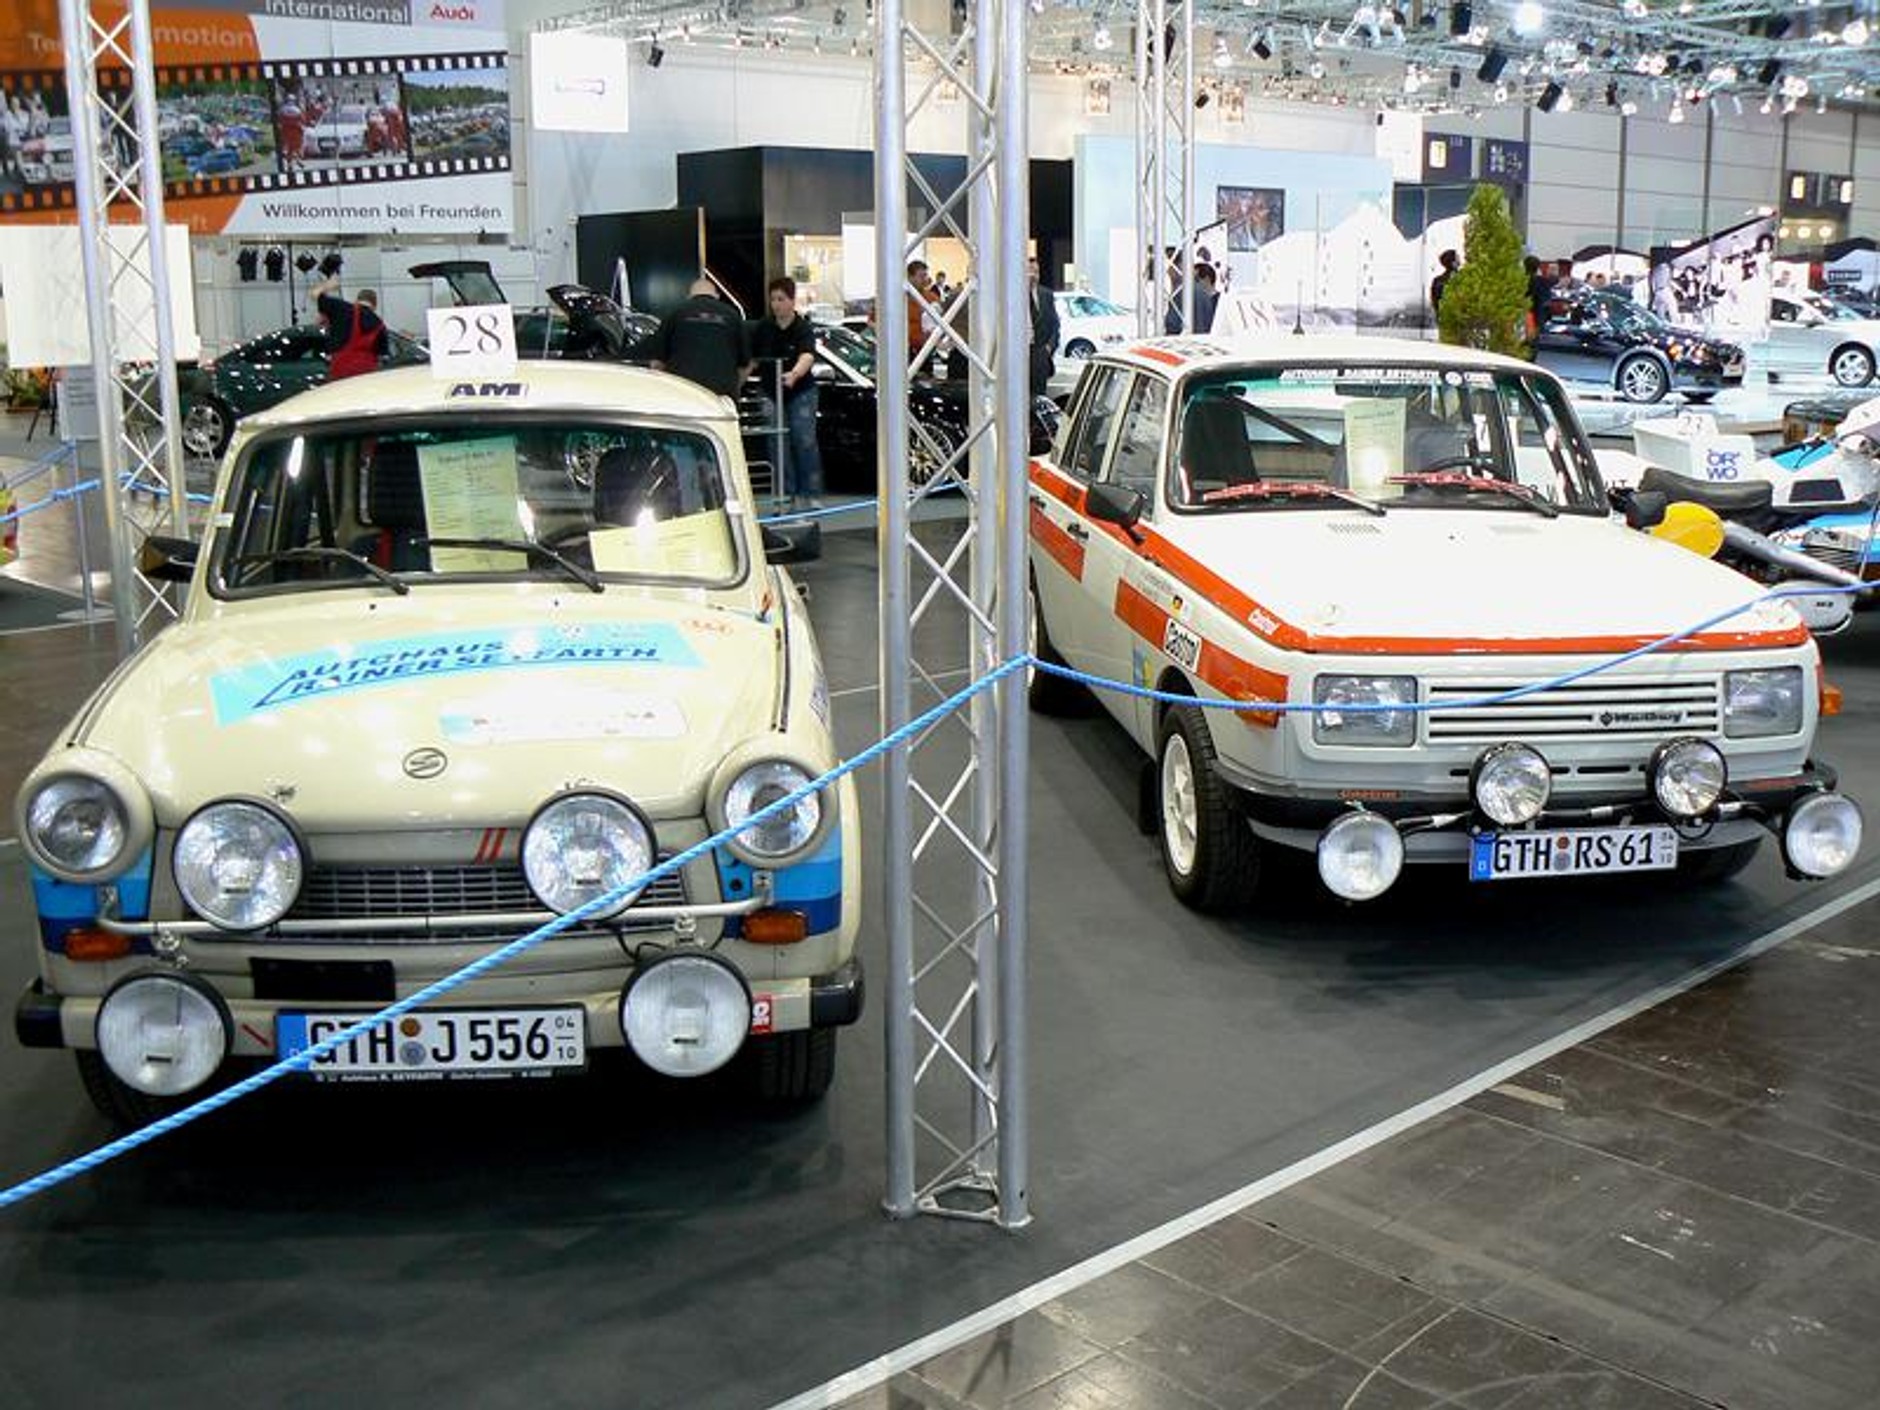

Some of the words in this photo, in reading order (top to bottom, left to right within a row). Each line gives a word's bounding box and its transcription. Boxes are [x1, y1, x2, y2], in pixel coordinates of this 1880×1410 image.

[264, 0, 408, 23] International
[430, 3, 475, 21] Audi
[262, 203, 380, 218] Willkommen
[386, 203, 415, 218] bei
[420, 204, 503, 219] Freunden
[443, 313, 503, 356] 28
[451, 382, 522, 397] AM
[292, 641, 504, 680] AUTOHAUS
[454, 646, 660, 667] SEFARTH
[1493, 836, 1551, 872] GTH
[1574, 835, 1613, 870] RS
[1619, 831, 1654, 866] 61
[555, 1015, 576, 1028] 04
[310, 1018, 395, 1064] GTH
[431, 1019, 457, 1063] J
[469, 1017, 551, 1062] 556
[557, 1047, 577, 1059] 10
